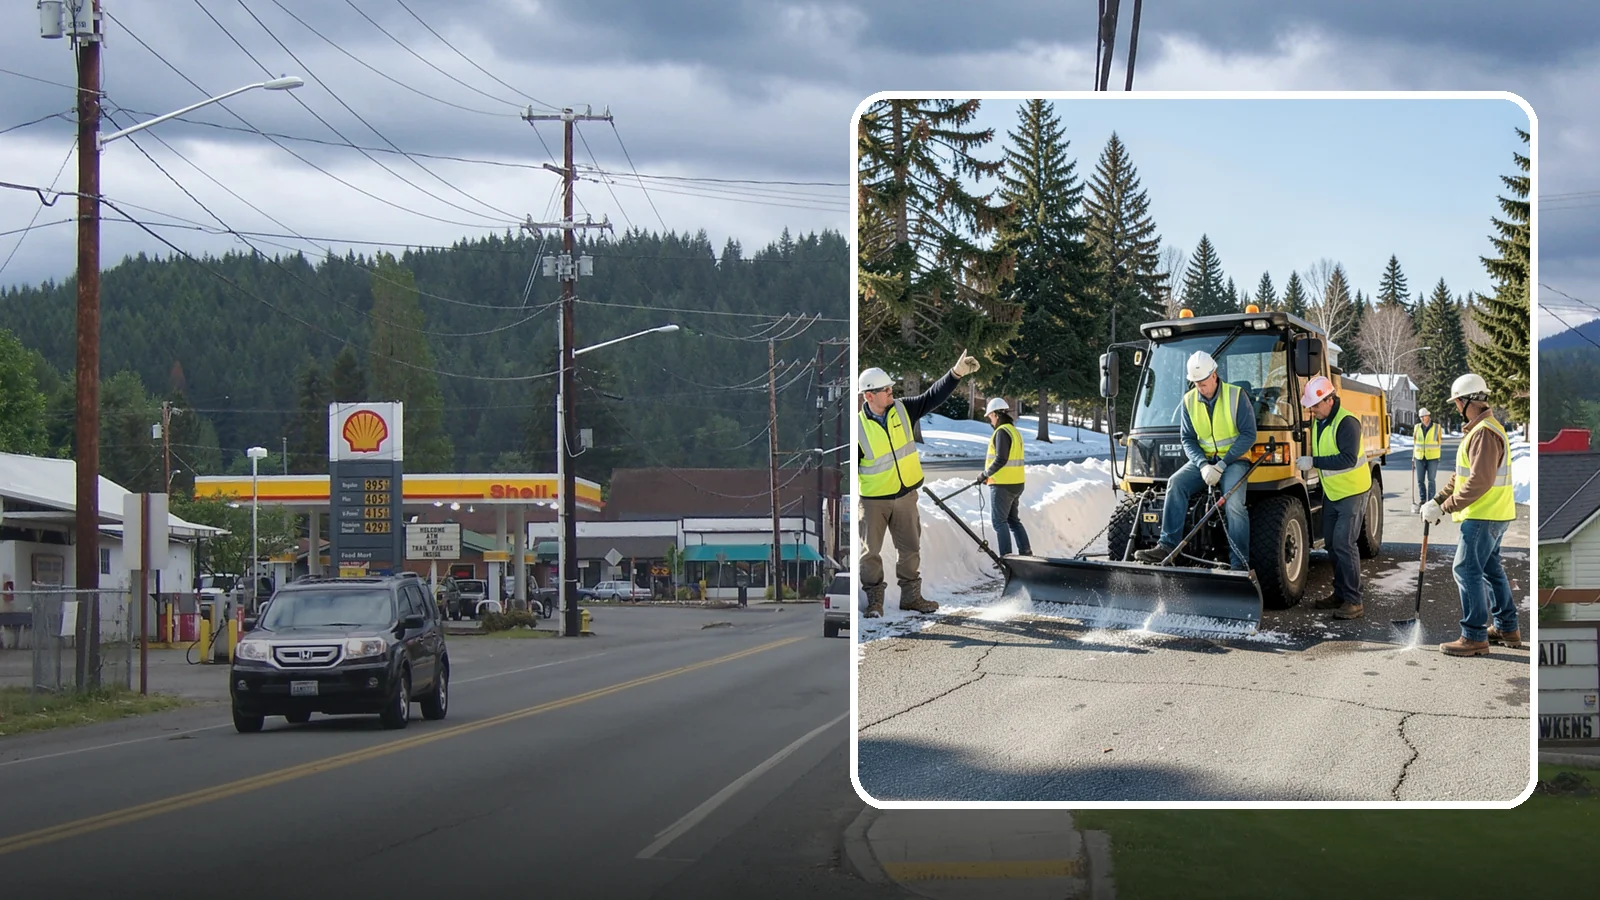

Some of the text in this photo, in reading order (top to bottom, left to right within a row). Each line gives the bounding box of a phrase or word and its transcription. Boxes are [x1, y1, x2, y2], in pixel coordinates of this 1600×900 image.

[366, 480, 383, 490] 395
[490, 484, 547, 498] Shell
[366, 494, 383, 504] 405
[366, 508, 383, 518] 415
[366, 522, 383, 532] 429
